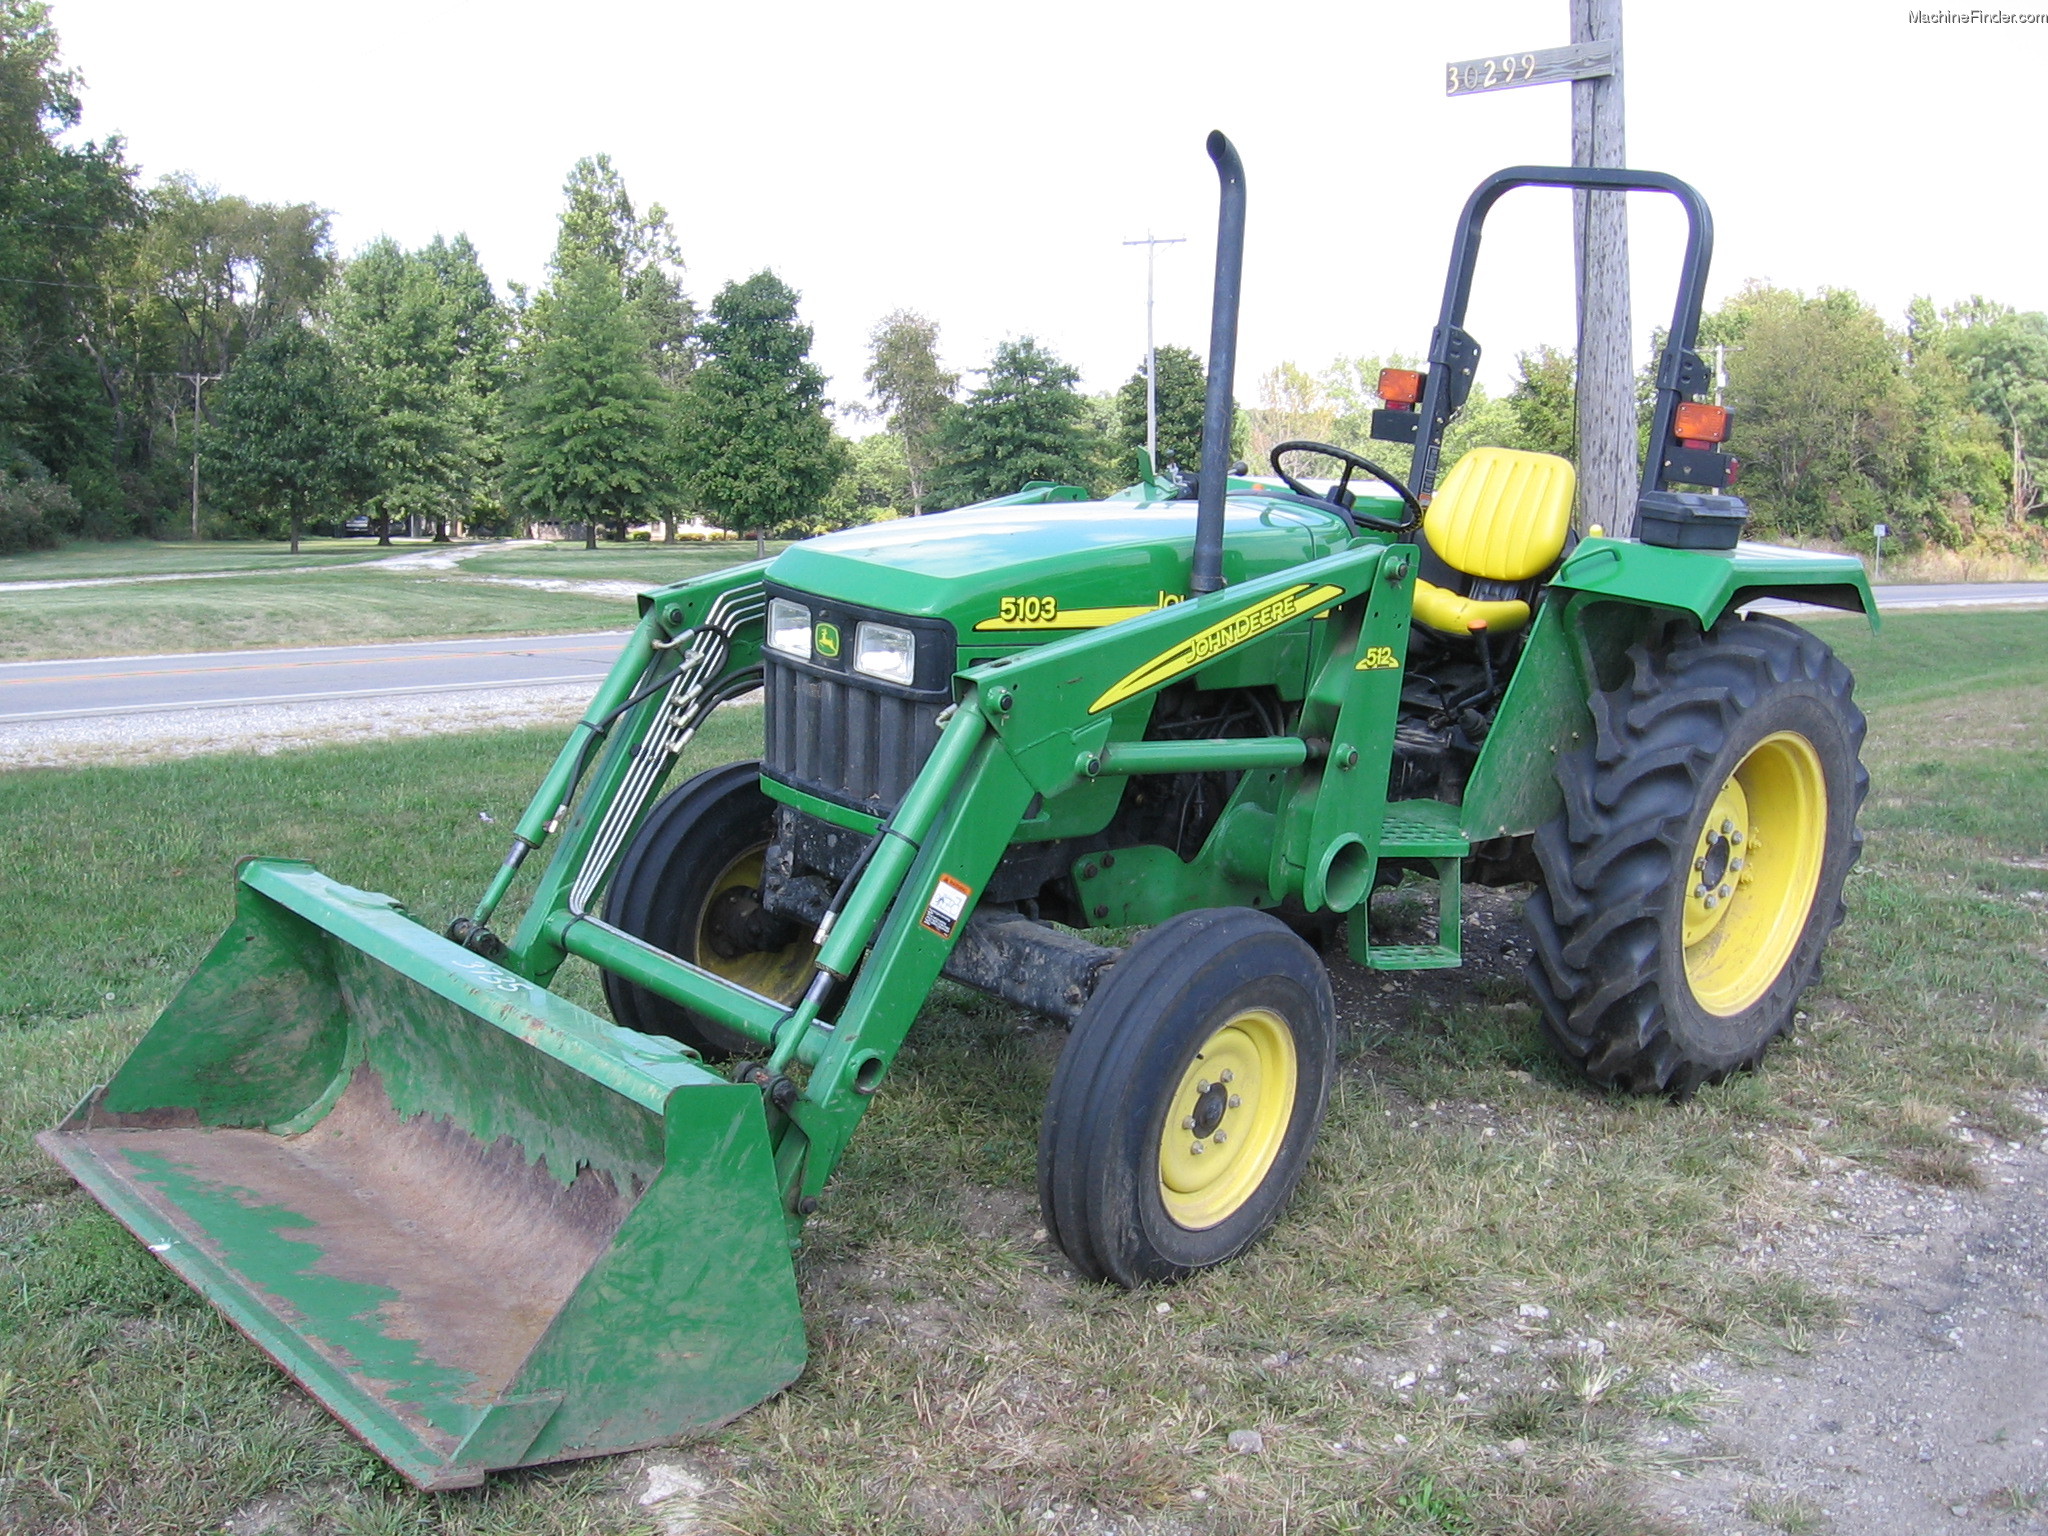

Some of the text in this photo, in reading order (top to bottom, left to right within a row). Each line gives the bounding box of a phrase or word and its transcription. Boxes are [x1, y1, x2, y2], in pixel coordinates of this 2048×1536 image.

[1447, 54, 1536, 93] 30299
[1000, 596, 1058, 621] 5103
[1186, 624, 1235, 663] JOHN
[1235, 595, 1297, 639] DEERE
[1366, 646, 1392, 667] 512
